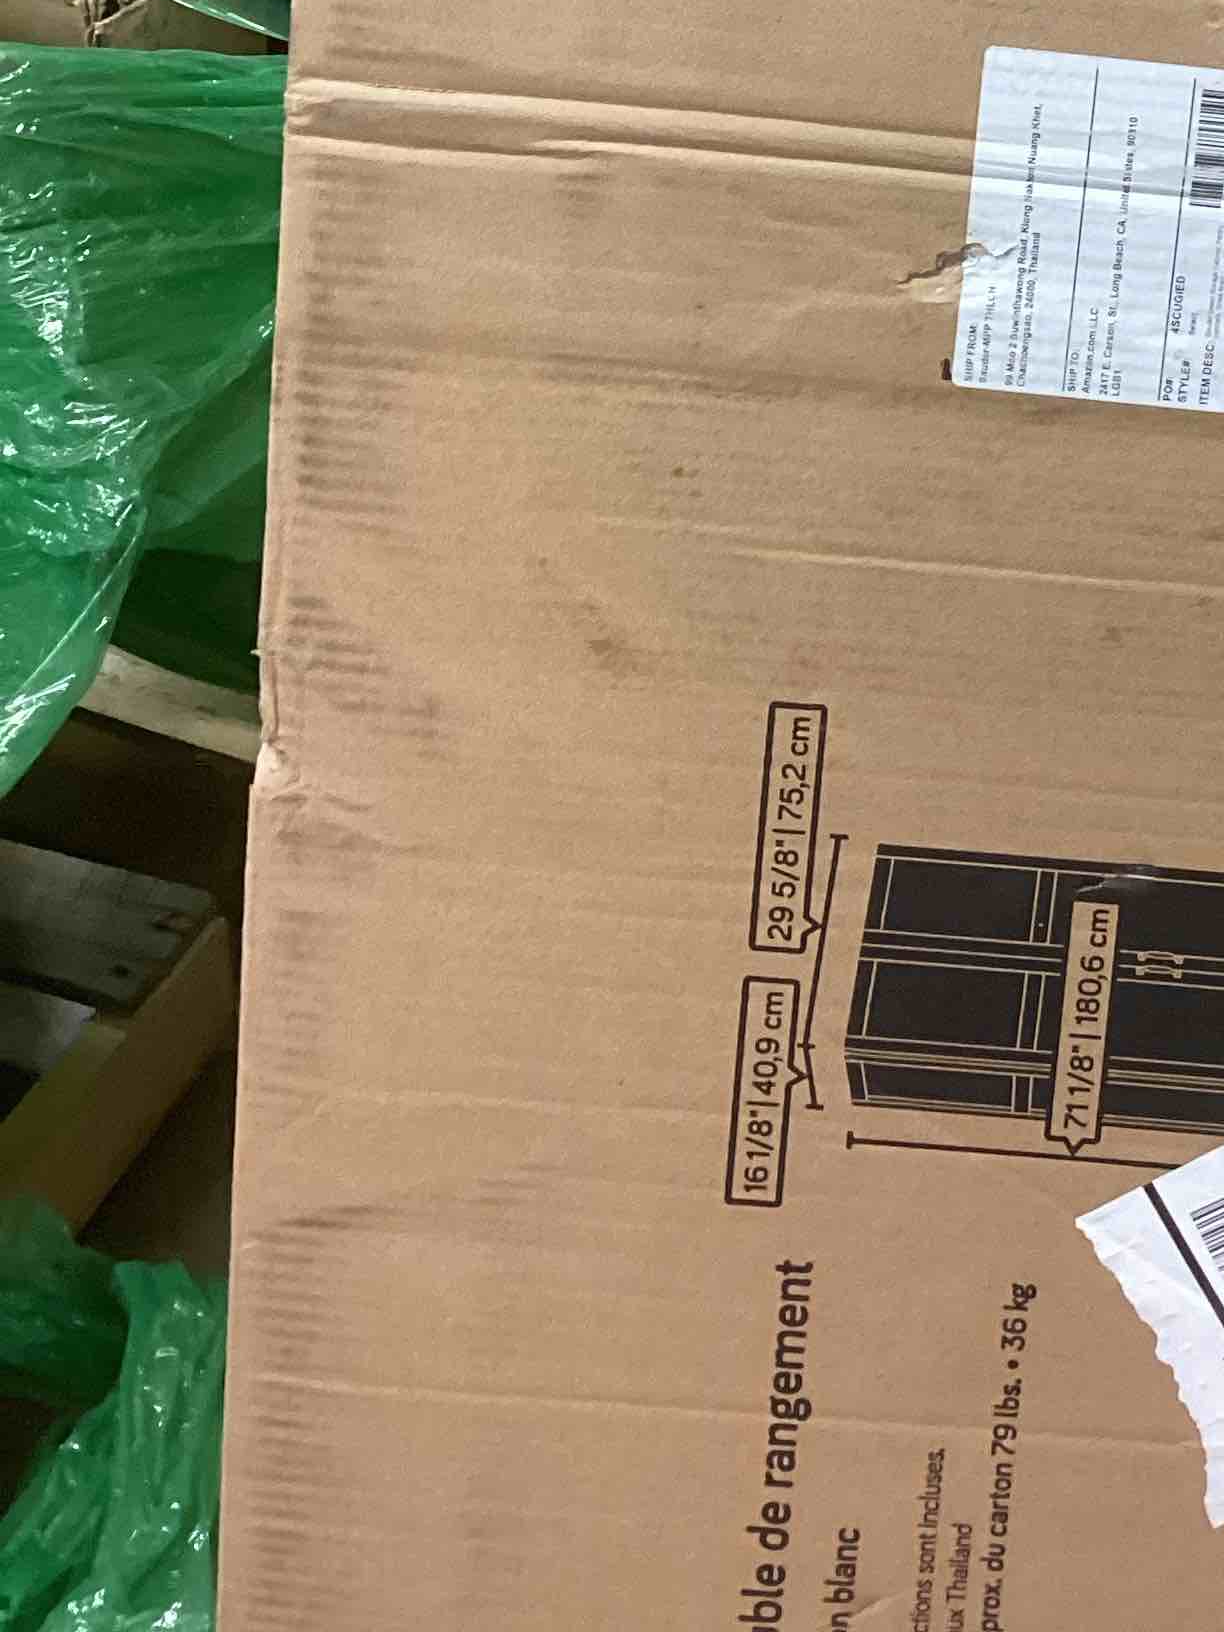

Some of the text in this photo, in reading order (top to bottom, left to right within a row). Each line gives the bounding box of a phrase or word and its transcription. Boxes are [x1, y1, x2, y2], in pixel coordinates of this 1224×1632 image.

[1029, 232, 1040, 273] Thailand
[1110, 273, 1122, 298] Long
[1067, 369, 1076, 392] SHIP
[1199, 378, 1211, 405] ITEM
[790, 716, 812, 758] cm
[777, 764, 810, 822] 75,2
[767, 905, 794, 941] 29
[1089, 908, 1110, 948] cm
[1075, 954, 1109, 1025] 180,6
[764, 991, 785, 1031] cm
[753, 1037, 782, 1097] 40,9
[1063, 1102, 1090, 1129] 71
[744, 1167, 769, 1194] 16
[1003, 1282, 1038, 1313] kg
[1001, 1317, 1028, 1352] 36
[993, 1377, 1023, 1420] lbs.
[737, 1258, 814, 1632] ble de rangement
[990, 1422, 1017, 1457] 79
[988, 1461, 1014, 1538] carton
[823, 1526, 861, 1604] blanc
[917, 1533, 937, 1575] sont
[945, 1521, 973, 1603] Thailand
[979, 1542, 1006, 1573] du
